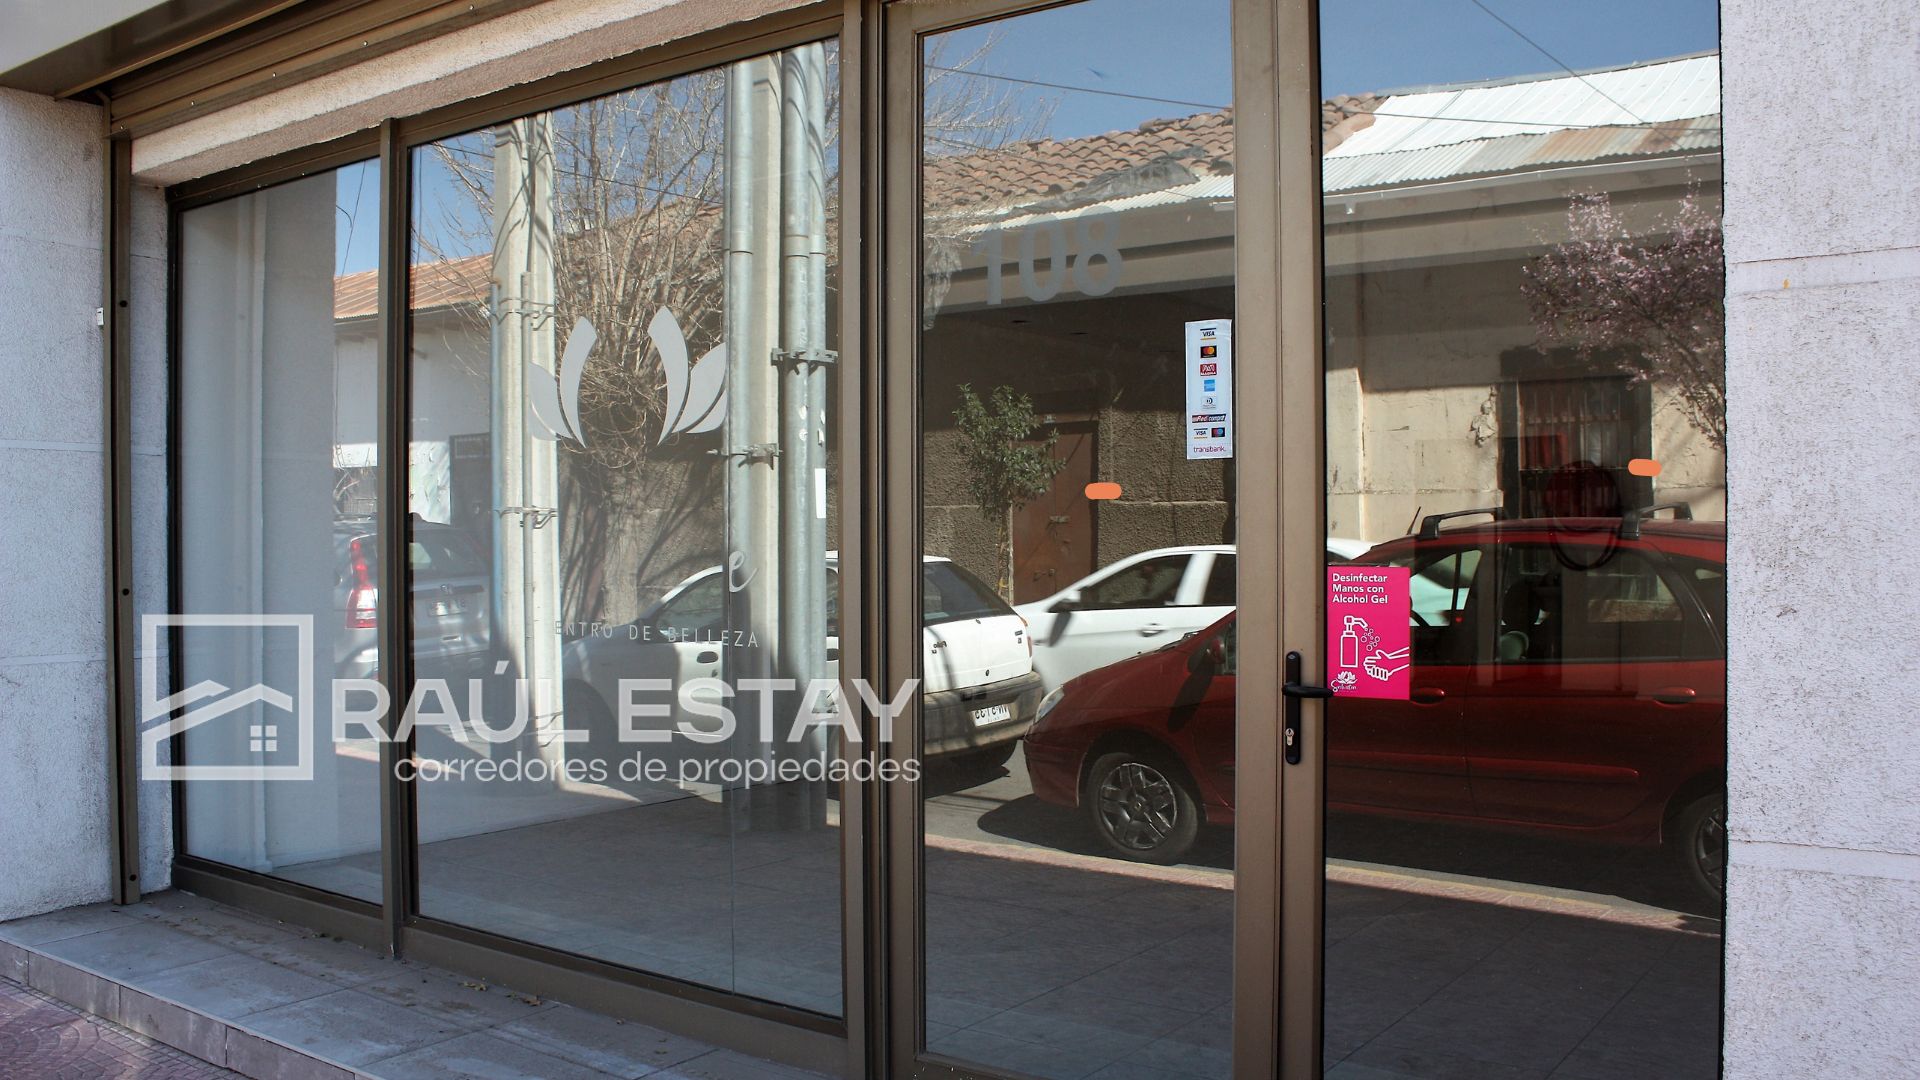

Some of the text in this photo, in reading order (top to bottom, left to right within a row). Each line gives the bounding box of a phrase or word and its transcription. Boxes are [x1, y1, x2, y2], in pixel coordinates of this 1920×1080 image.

[970, 205, 1123, 305] 108
[1332, 573, 1388, 583] Desinfectar
[1332, 583, 1385, 593] Manos con
[1332, 594, 1389, 604] Alcohol Gel
[555, 620, 759, 648] ENTRO DE BELLEZA
